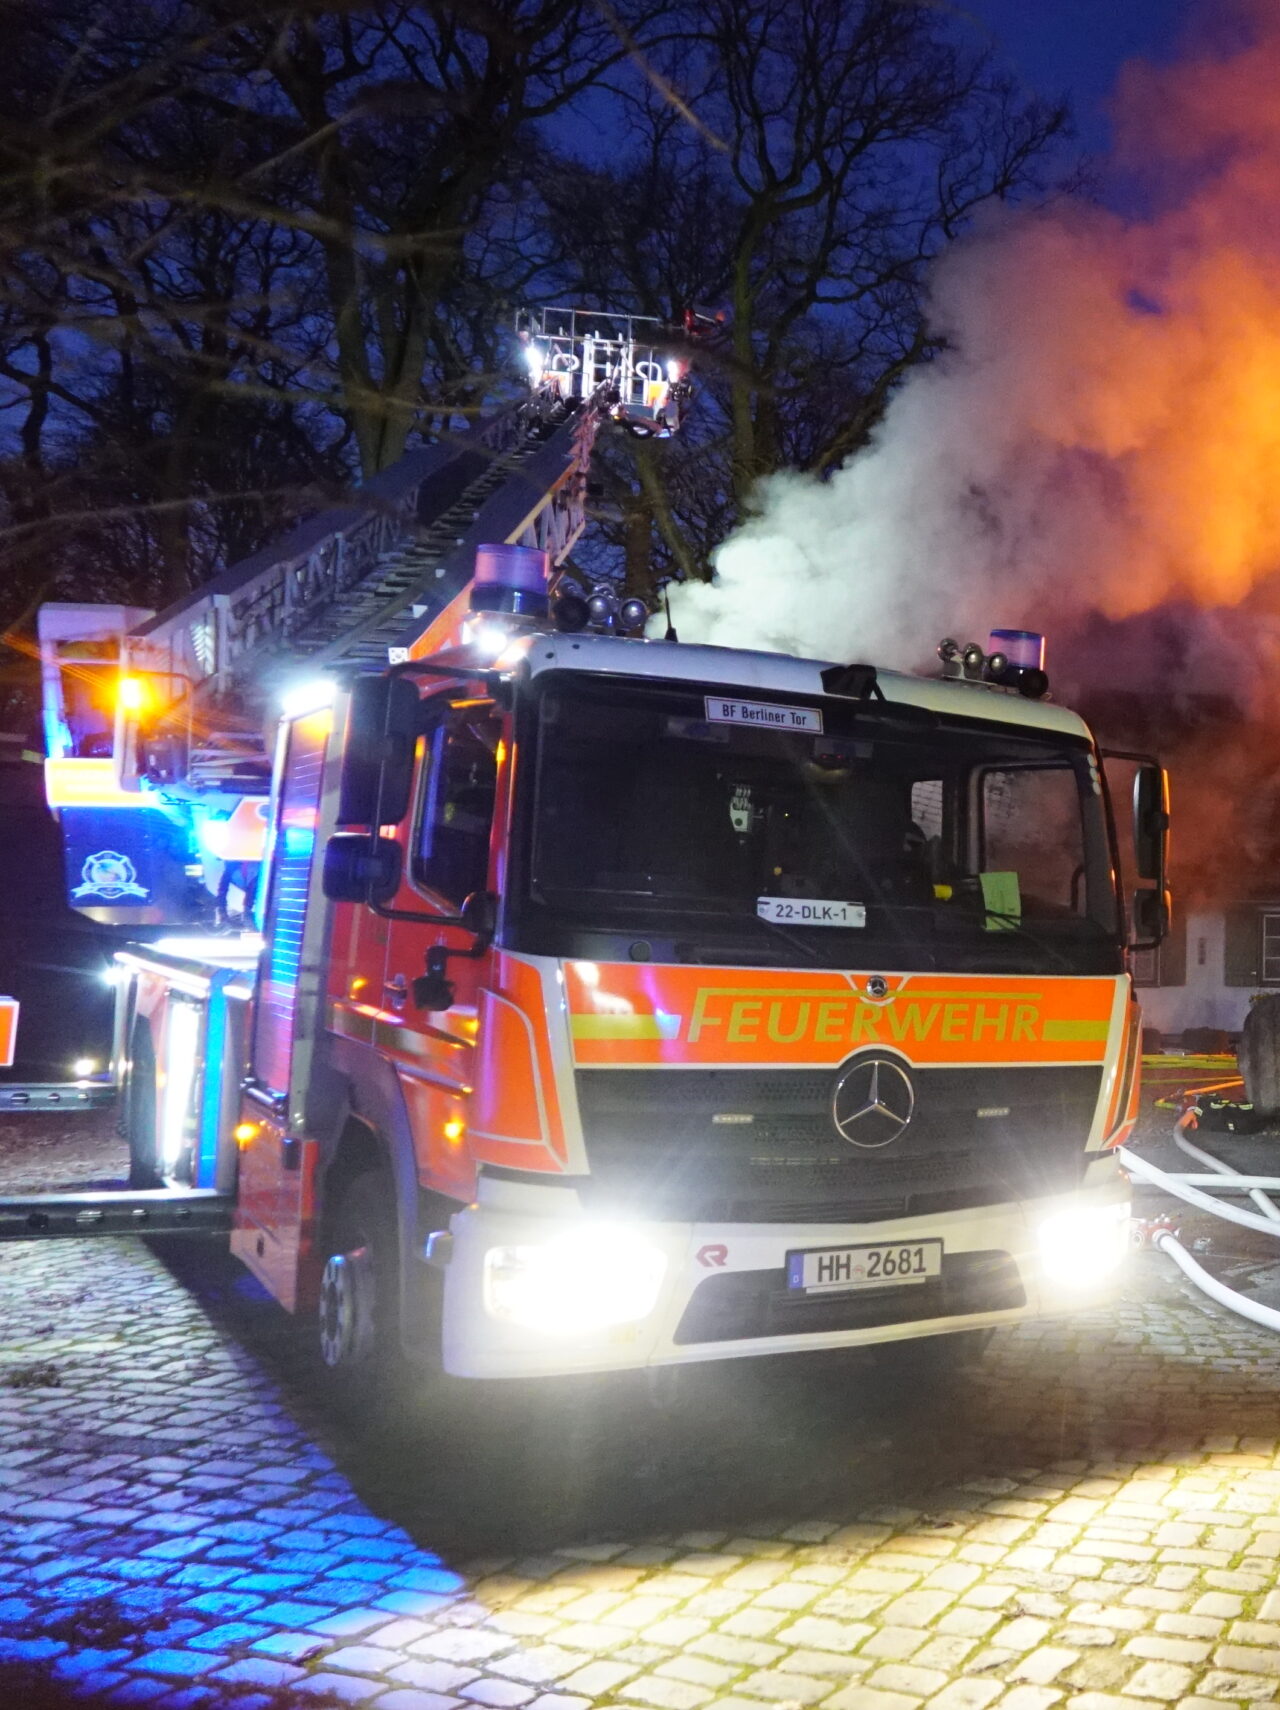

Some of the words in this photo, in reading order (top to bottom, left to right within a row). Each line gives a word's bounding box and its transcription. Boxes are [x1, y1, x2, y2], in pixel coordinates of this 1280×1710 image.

[722, 704, 736, 718] BF
[742, 706, 786, 723] Berliner
[790, 711, 807, 726] Tor
[776, 904, 848, 921] 22-DLK-1
[687, 987, 1040, 1043] FEUERWEHR
[817, 1253, 851, 1283] HH
[866, 1247, 927, 1279] 2681
